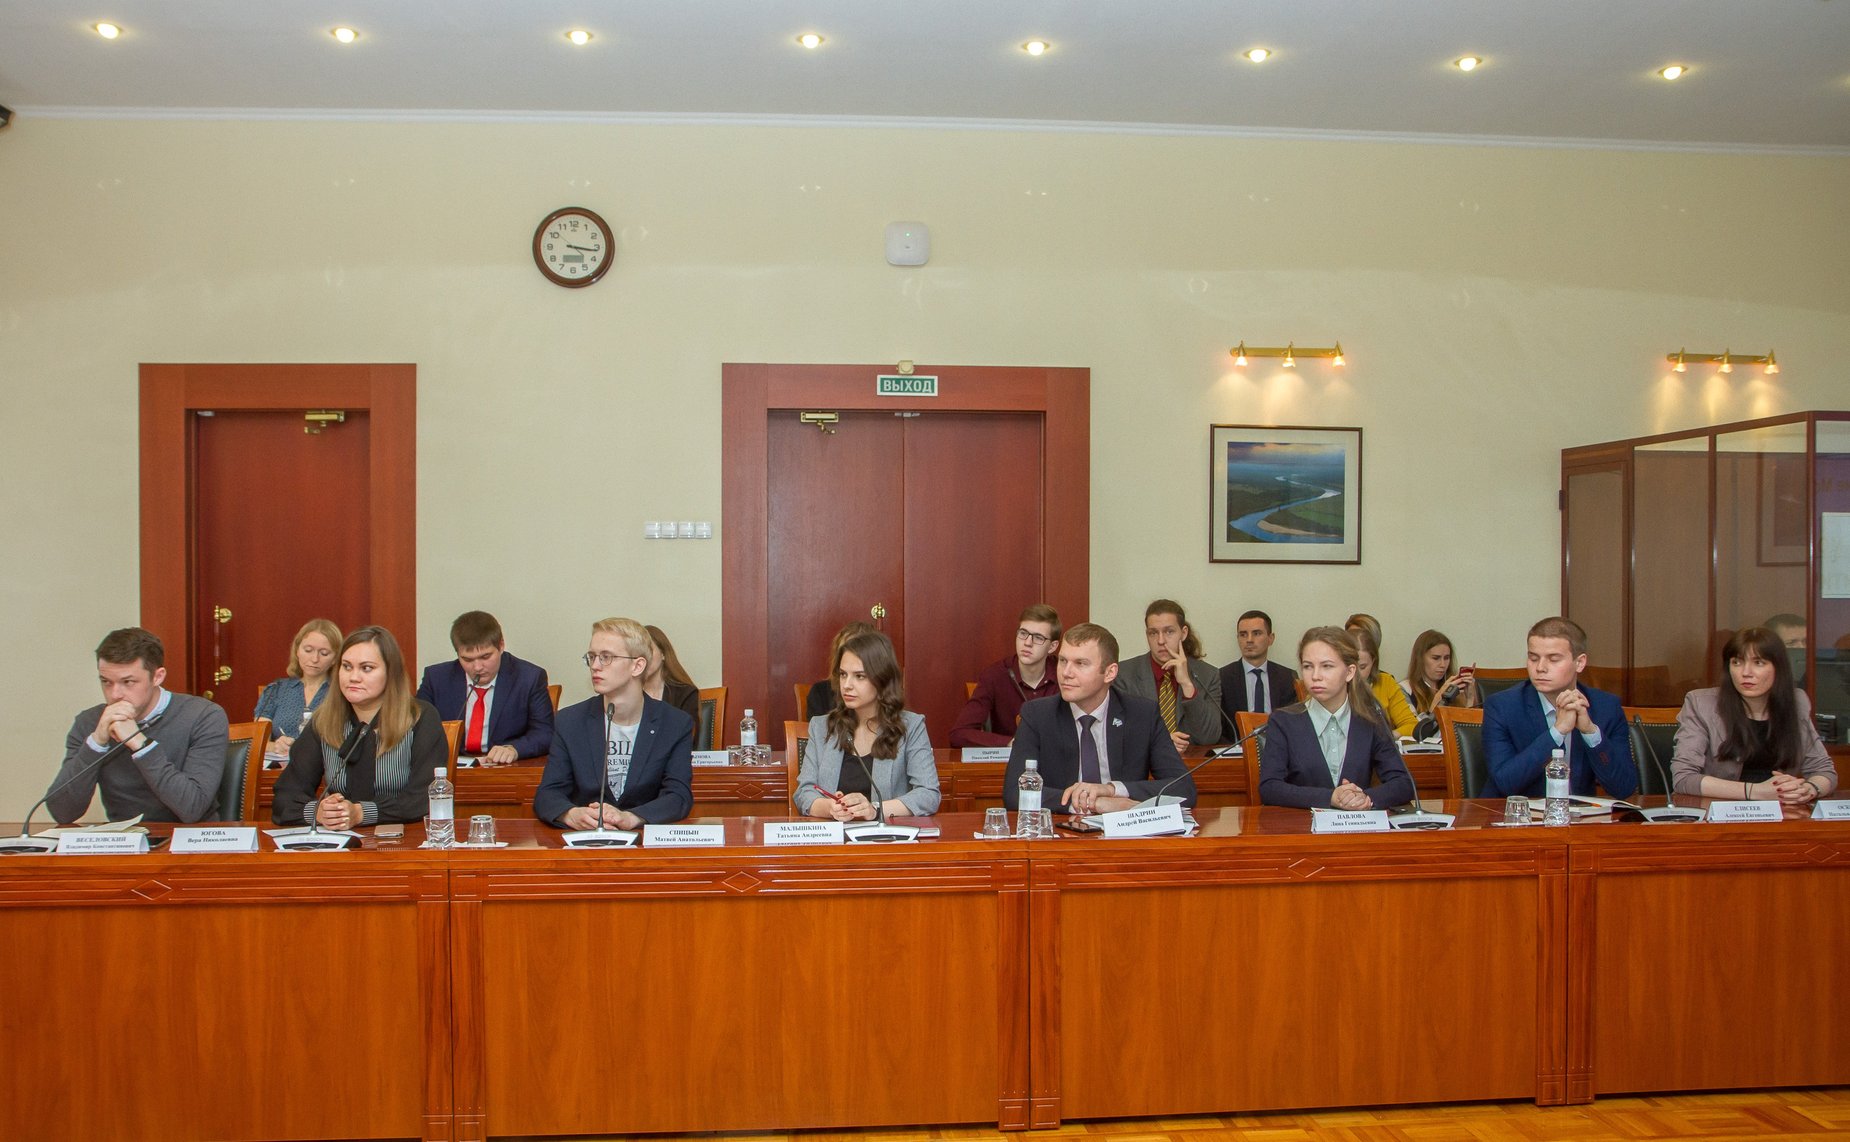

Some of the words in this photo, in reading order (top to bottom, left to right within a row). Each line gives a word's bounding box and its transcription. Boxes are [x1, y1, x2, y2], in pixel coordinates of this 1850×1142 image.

[590, 232, 597, 240] 2
[546, 243, 554, 251] 9
[559, 263, 565, 271] 7
[570, 266, 577, 274] 6
[582, 263, 589, 271] 5
[883, 380, 932, 392] ВЫХОД
[1127, 809, 1156, 818] ШАДРИН
[1116, 820, 1138, 828] Андрей
[1138, 815, 1172, 824] Васильевич
